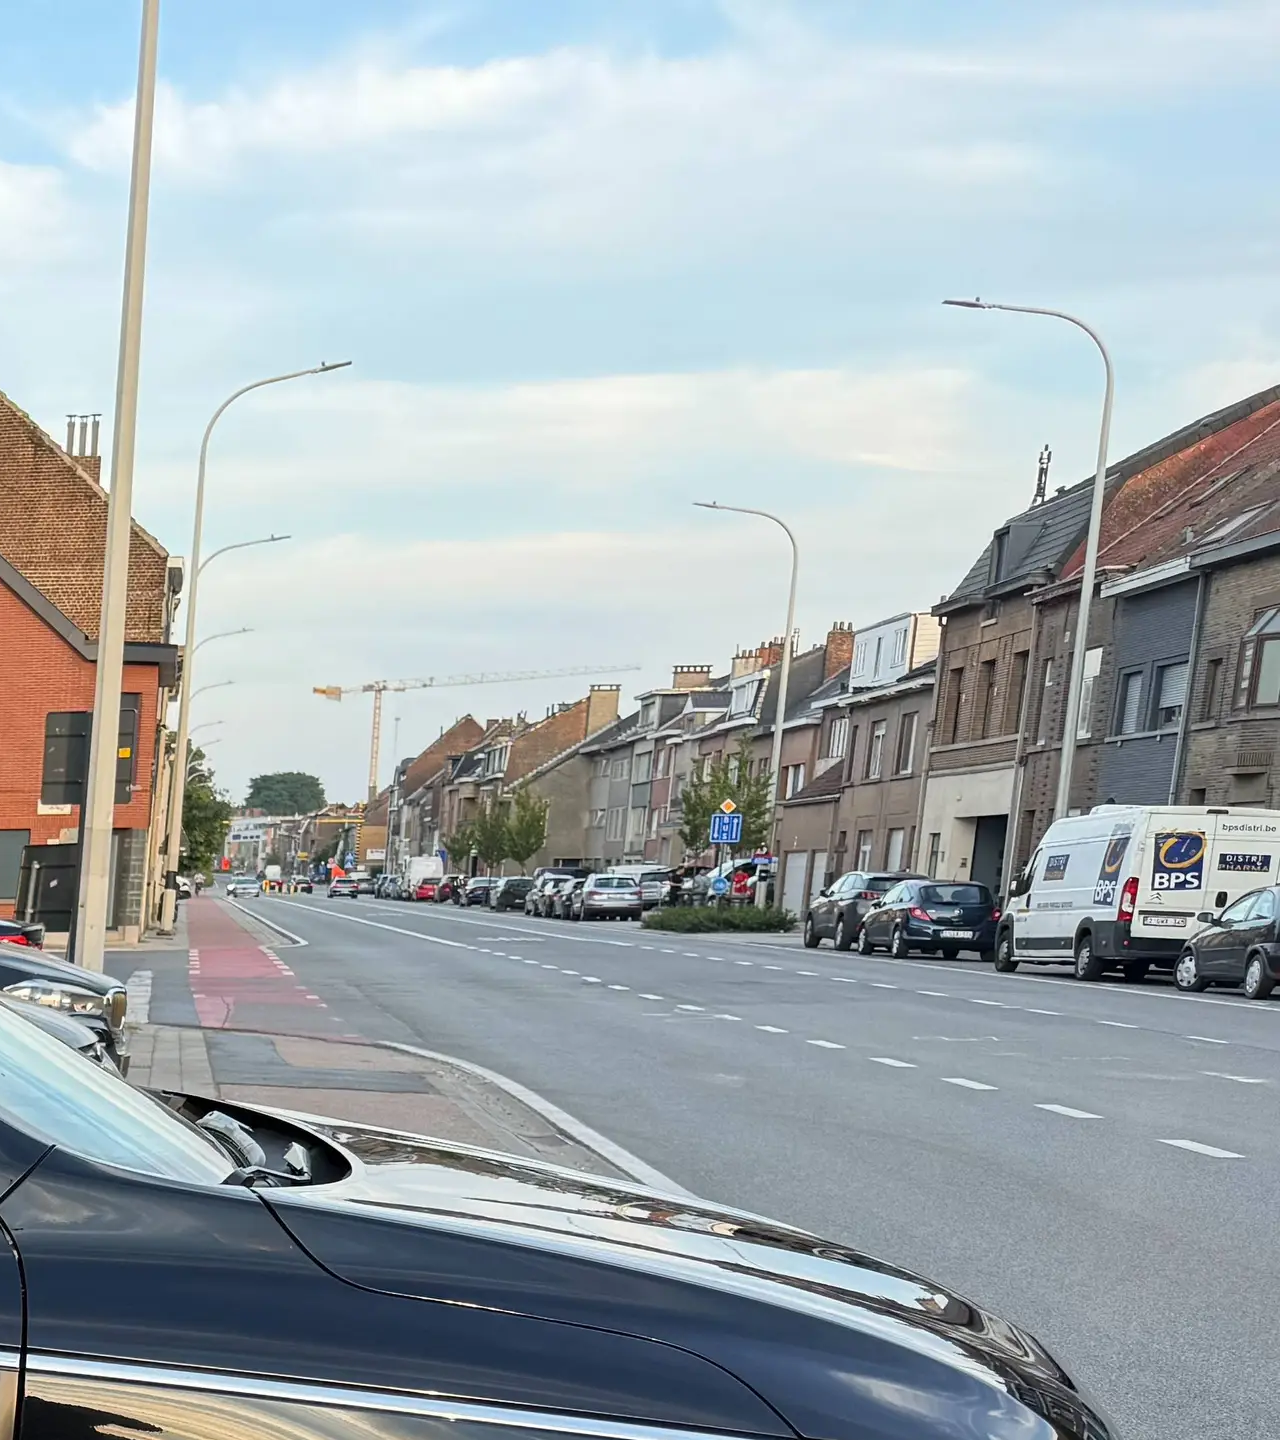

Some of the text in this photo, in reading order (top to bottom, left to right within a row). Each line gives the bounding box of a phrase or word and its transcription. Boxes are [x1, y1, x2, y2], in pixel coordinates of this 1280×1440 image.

[721, 816, 730, 840] BUS
[1222, 823, 1277, 832] bpsdistri.be
[1094, 879, 1117, 903] BPS
[1152, 872, 1200, 890] BPS
